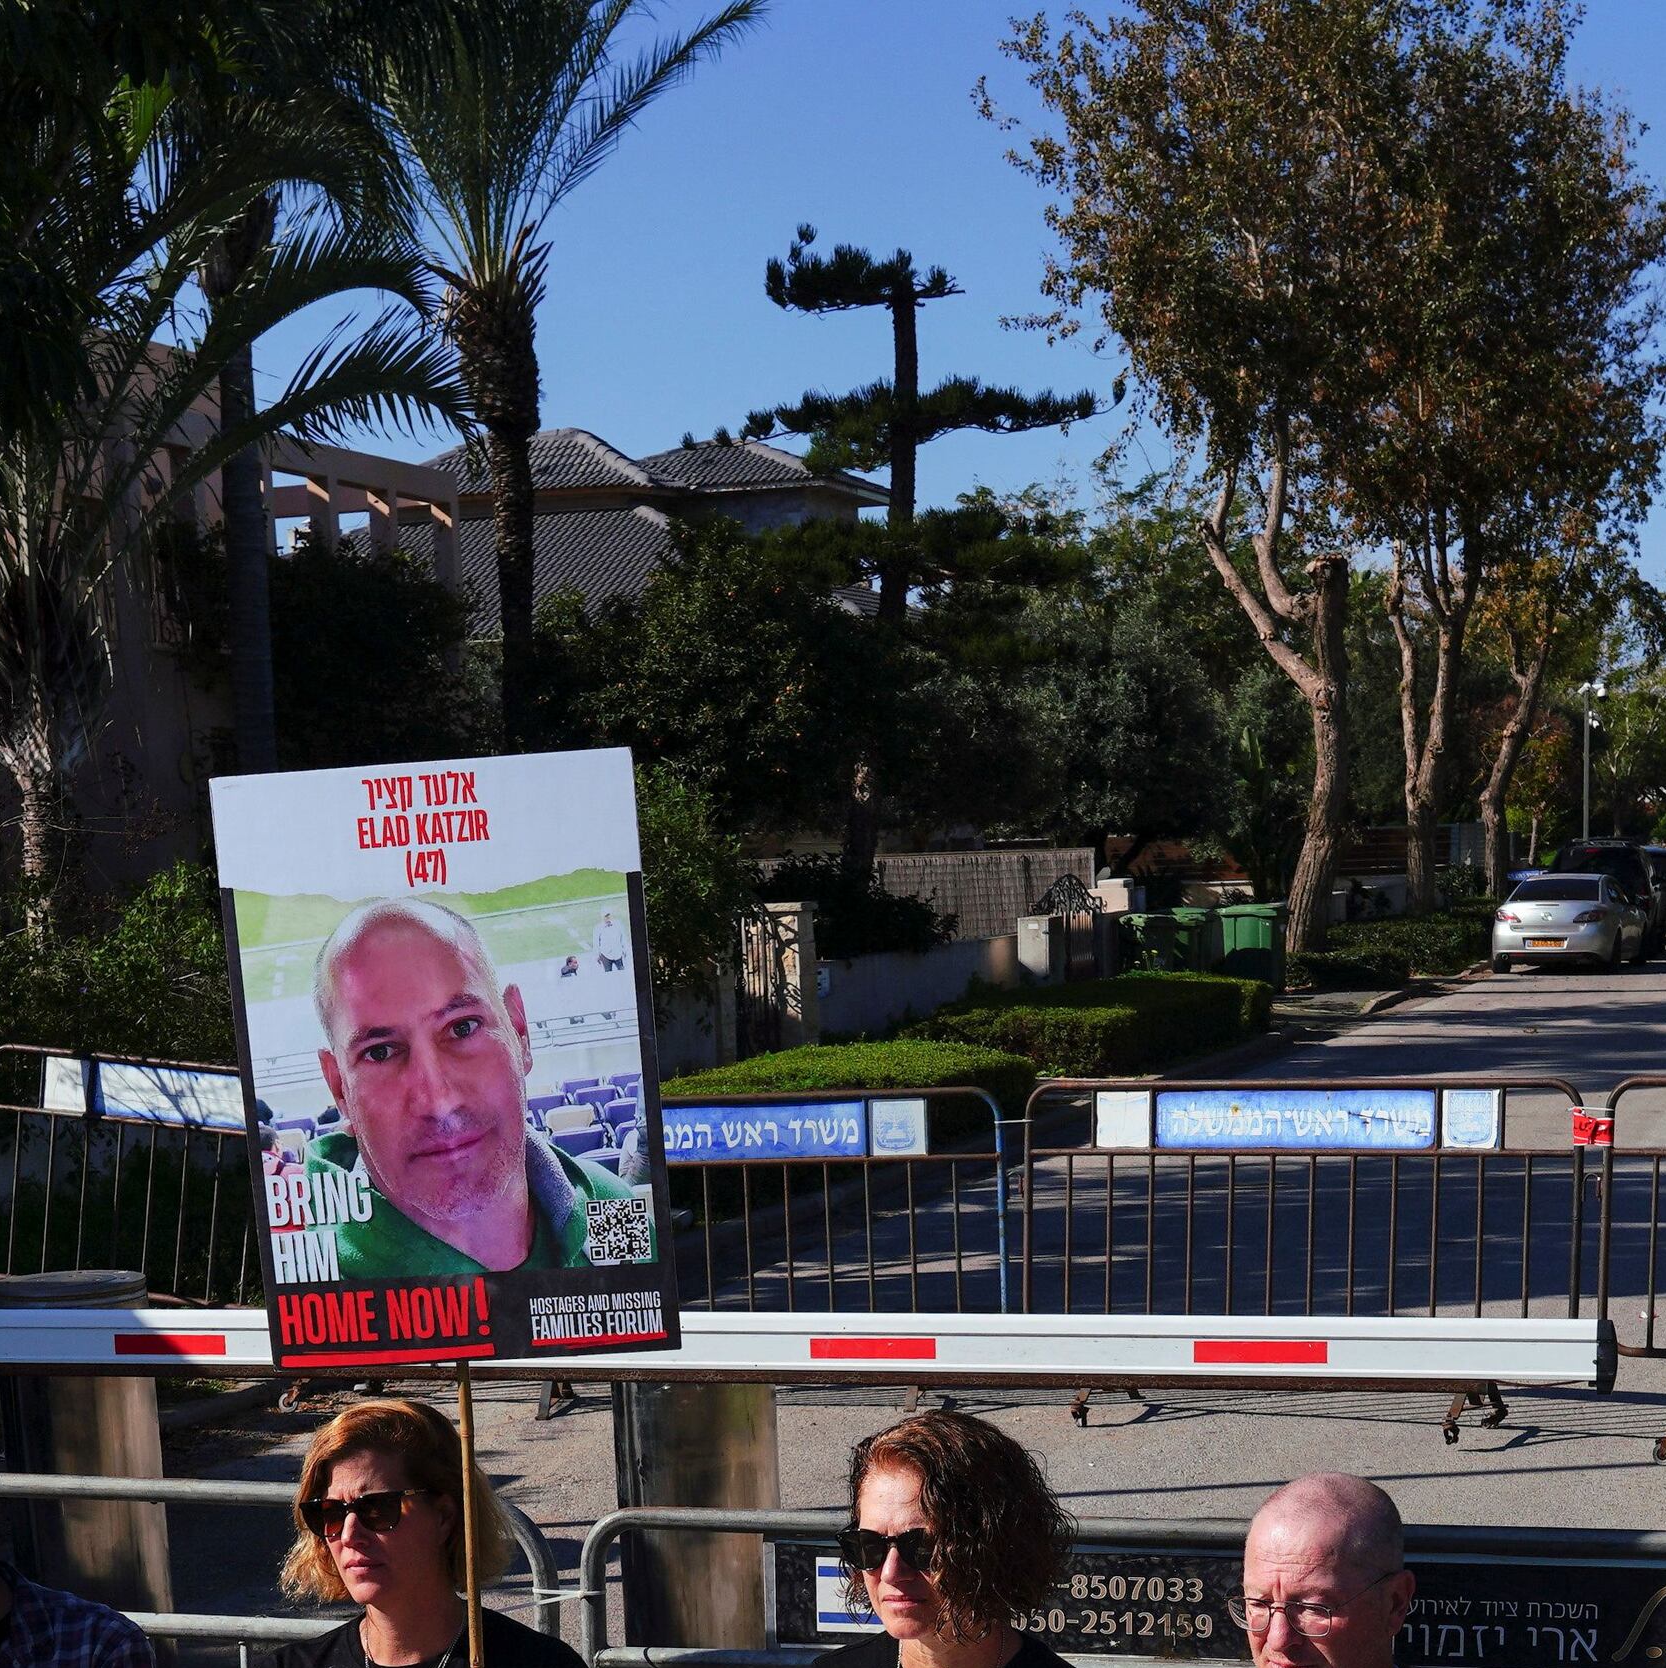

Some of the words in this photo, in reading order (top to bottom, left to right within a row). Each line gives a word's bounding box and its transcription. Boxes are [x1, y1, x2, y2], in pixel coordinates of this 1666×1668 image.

[362, 776, 415, 811] קציר
[419, 772, 478, 807] אלעד
[357, 813, 410, 850] ELAD
[415, 809, 490, 846] KATZIR
[405, 849, 449, 888] (47)
[664, 1121, 713, 1150] הממ
[720, 1119, 780, 1149] ראש
[787, 1117, 859, 1146] משרד
[1171, 1102, 1283, 1138] הממשלה
[1290, 1108, 1349, 1138] ראש
[1361, 1109, 1433, 1138] משרד
[264, 1169, 373, 1228] BRING
[272, 1228, 341, 1285] HIM
[277, 1289, 378, 1347] HOME
[386, 1276, 492, 1343] NOW!
[529, 1296, 586, 1316] HOSTAGES
[587, 1294, 610, 1314] AND
[611, 1290, 661, 1311] MISSING
[531, 1312, 603, 1342] FAMILIES
[605, 1308, 664, 1338] FORUM
[1057, 1573, 1204, 1603] -8507033
[1406, 1595, 1472, 1617] לאירוע
[1480, 1600, 1519, 1618] ציוד
[1526, 1600, 1599, 1620] השכרת
[1010, 1607, 1213, 1639] 050-2512159
[1391, 1622, 1505, 1659] יזמוי
[1533, 1626, 1599, 1662] ארי
